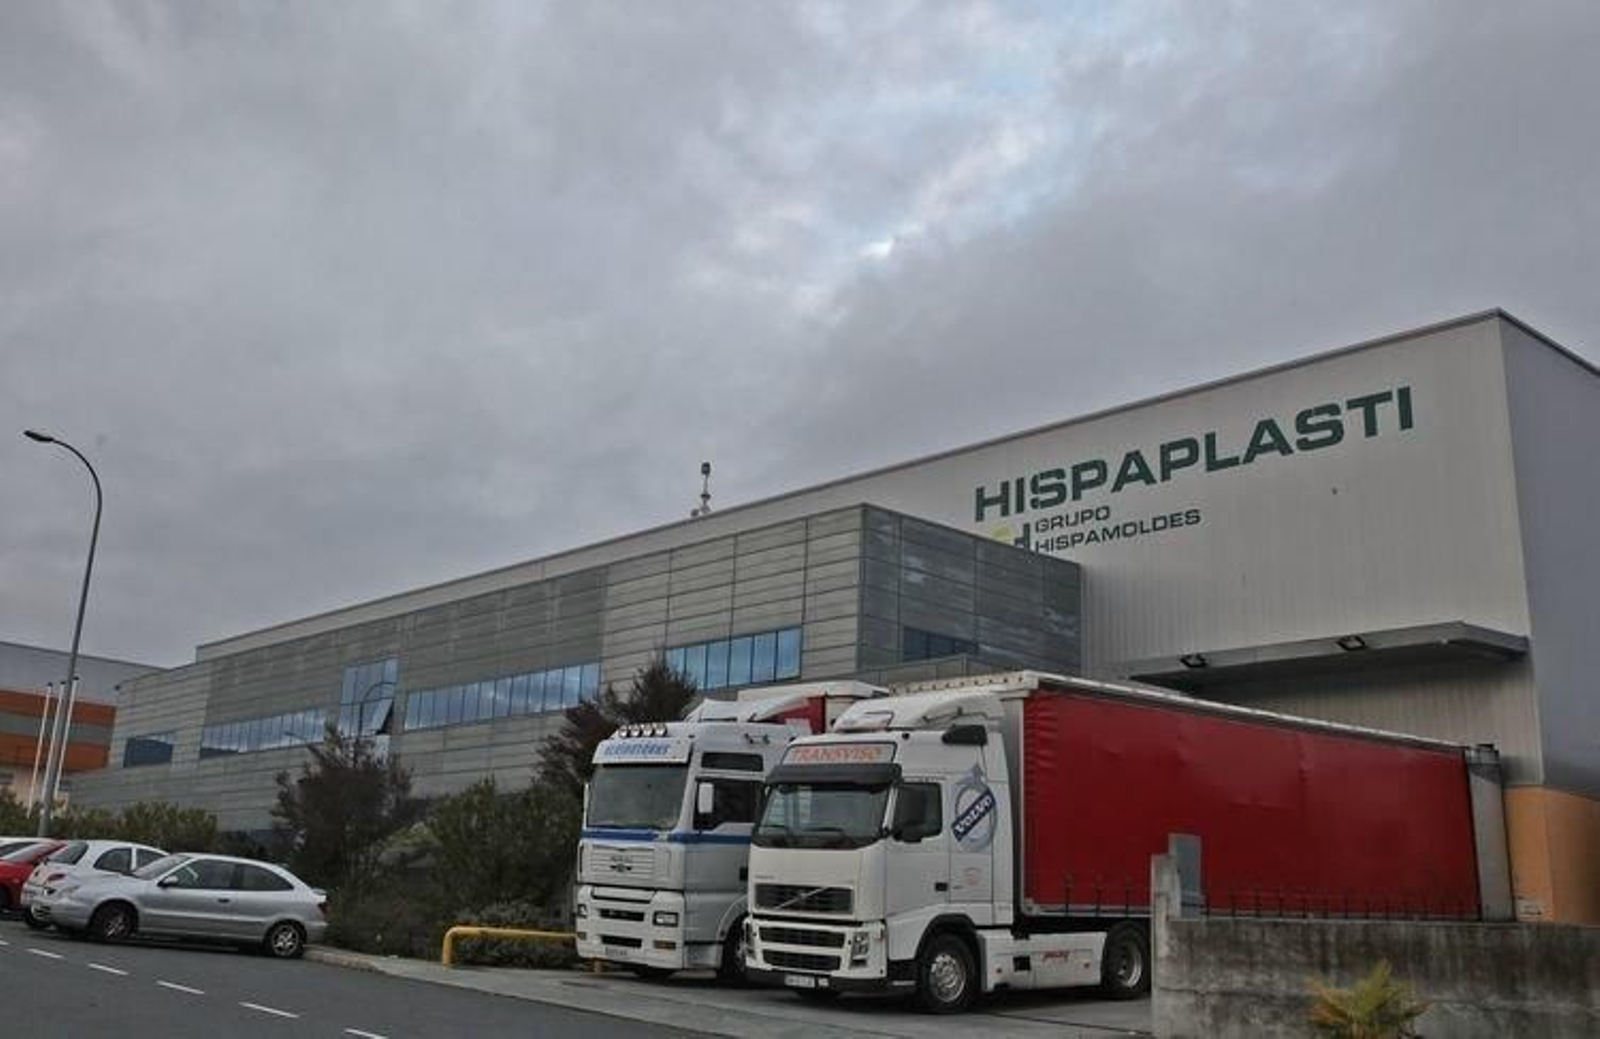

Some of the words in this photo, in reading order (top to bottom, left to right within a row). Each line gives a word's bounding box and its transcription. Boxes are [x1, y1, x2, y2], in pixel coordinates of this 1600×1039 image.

[974, 386, 1413, 522] HISPAPLASTI
[1034, 508, 1202, 553] HISPAMOLDES
[1035, 505, 1111, 533] GRUPO
